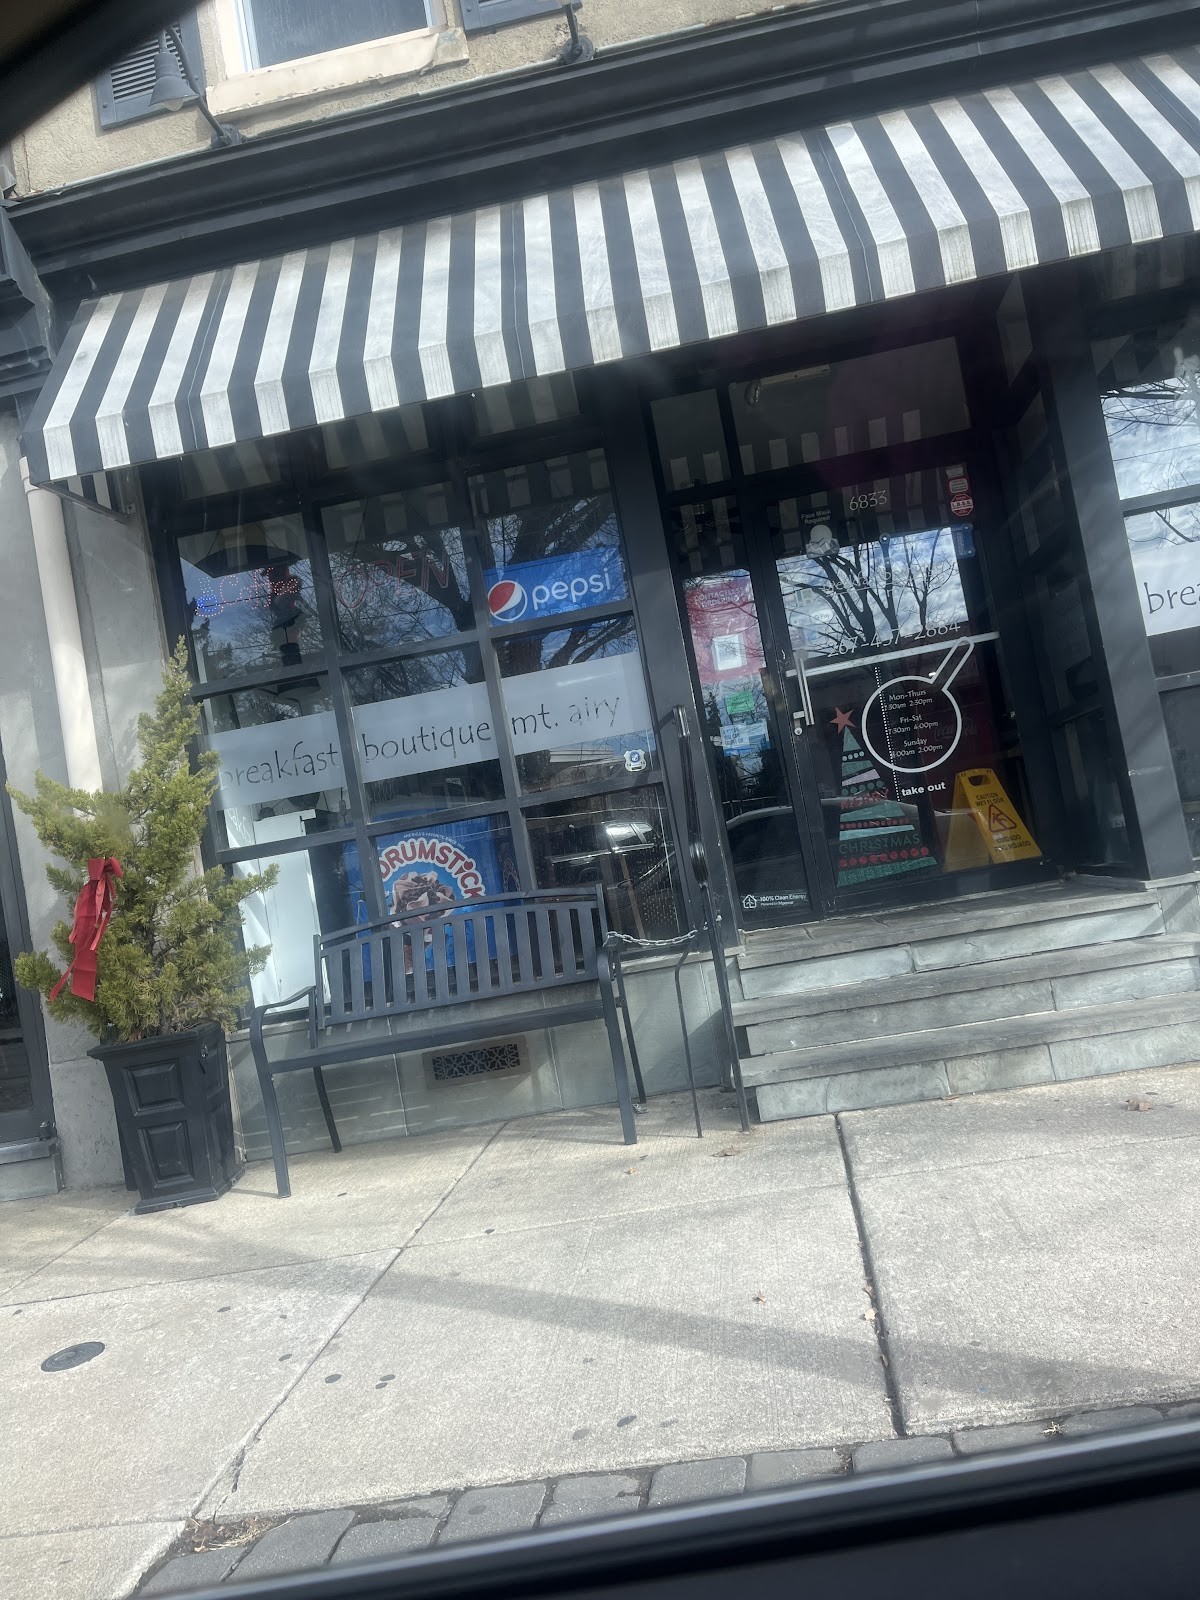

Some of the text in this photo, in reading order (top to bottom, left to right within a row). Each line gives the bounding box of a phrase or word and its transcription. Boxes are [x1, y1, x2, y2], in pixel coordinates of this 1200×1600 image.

[849, 489, 888, 511] 6833
[801, 512, 815, 520] Face
[531, 567, 612, 611] pepsi
[1143, 581, 1200, 614] bre
[888, 689, 927, 701] Mon-Thurs
[899, 713, 923, 724] Fri-Sat
[361, 721, 492, 764] boutique
[511, 703, 559, 736] mt.
[568, 696, 620, 728] airy
[903, 737, 928, 748] Sunday
[901, 781, 947, 797] take out
[975, 791, 1000, 801] CAUTION
[839, 833, 921, 854] CHRISTMAS
